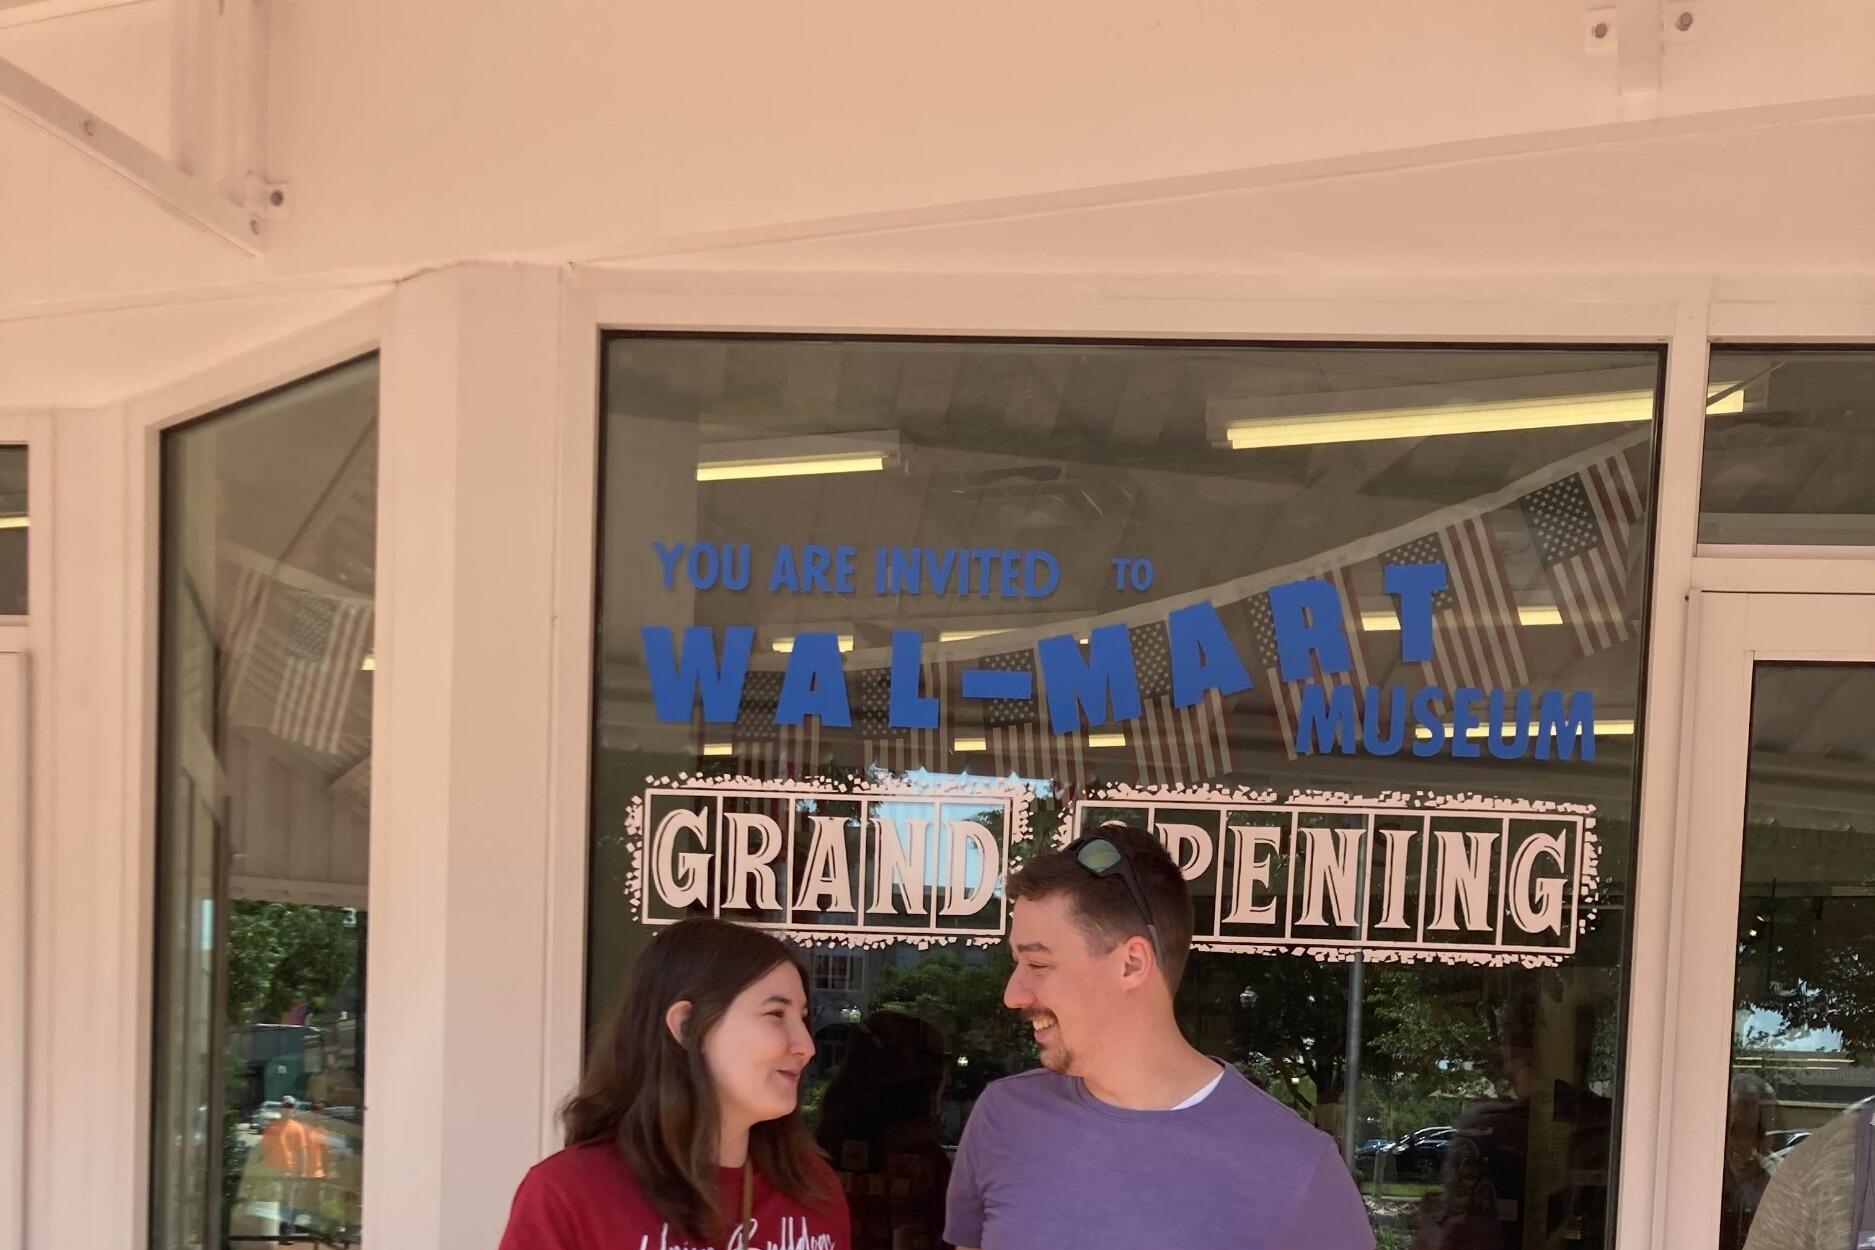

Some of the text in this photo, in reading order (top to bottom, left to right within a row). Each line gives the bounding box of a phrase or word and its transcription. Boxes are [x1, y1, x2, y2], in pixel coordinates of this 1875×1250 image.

[653, 540, 1155, 598] YOU ARE INVITED TO
[1295, 683, 1597, 761] MUSEUM
[651, 805, 1569, 937] GRAND PENING
